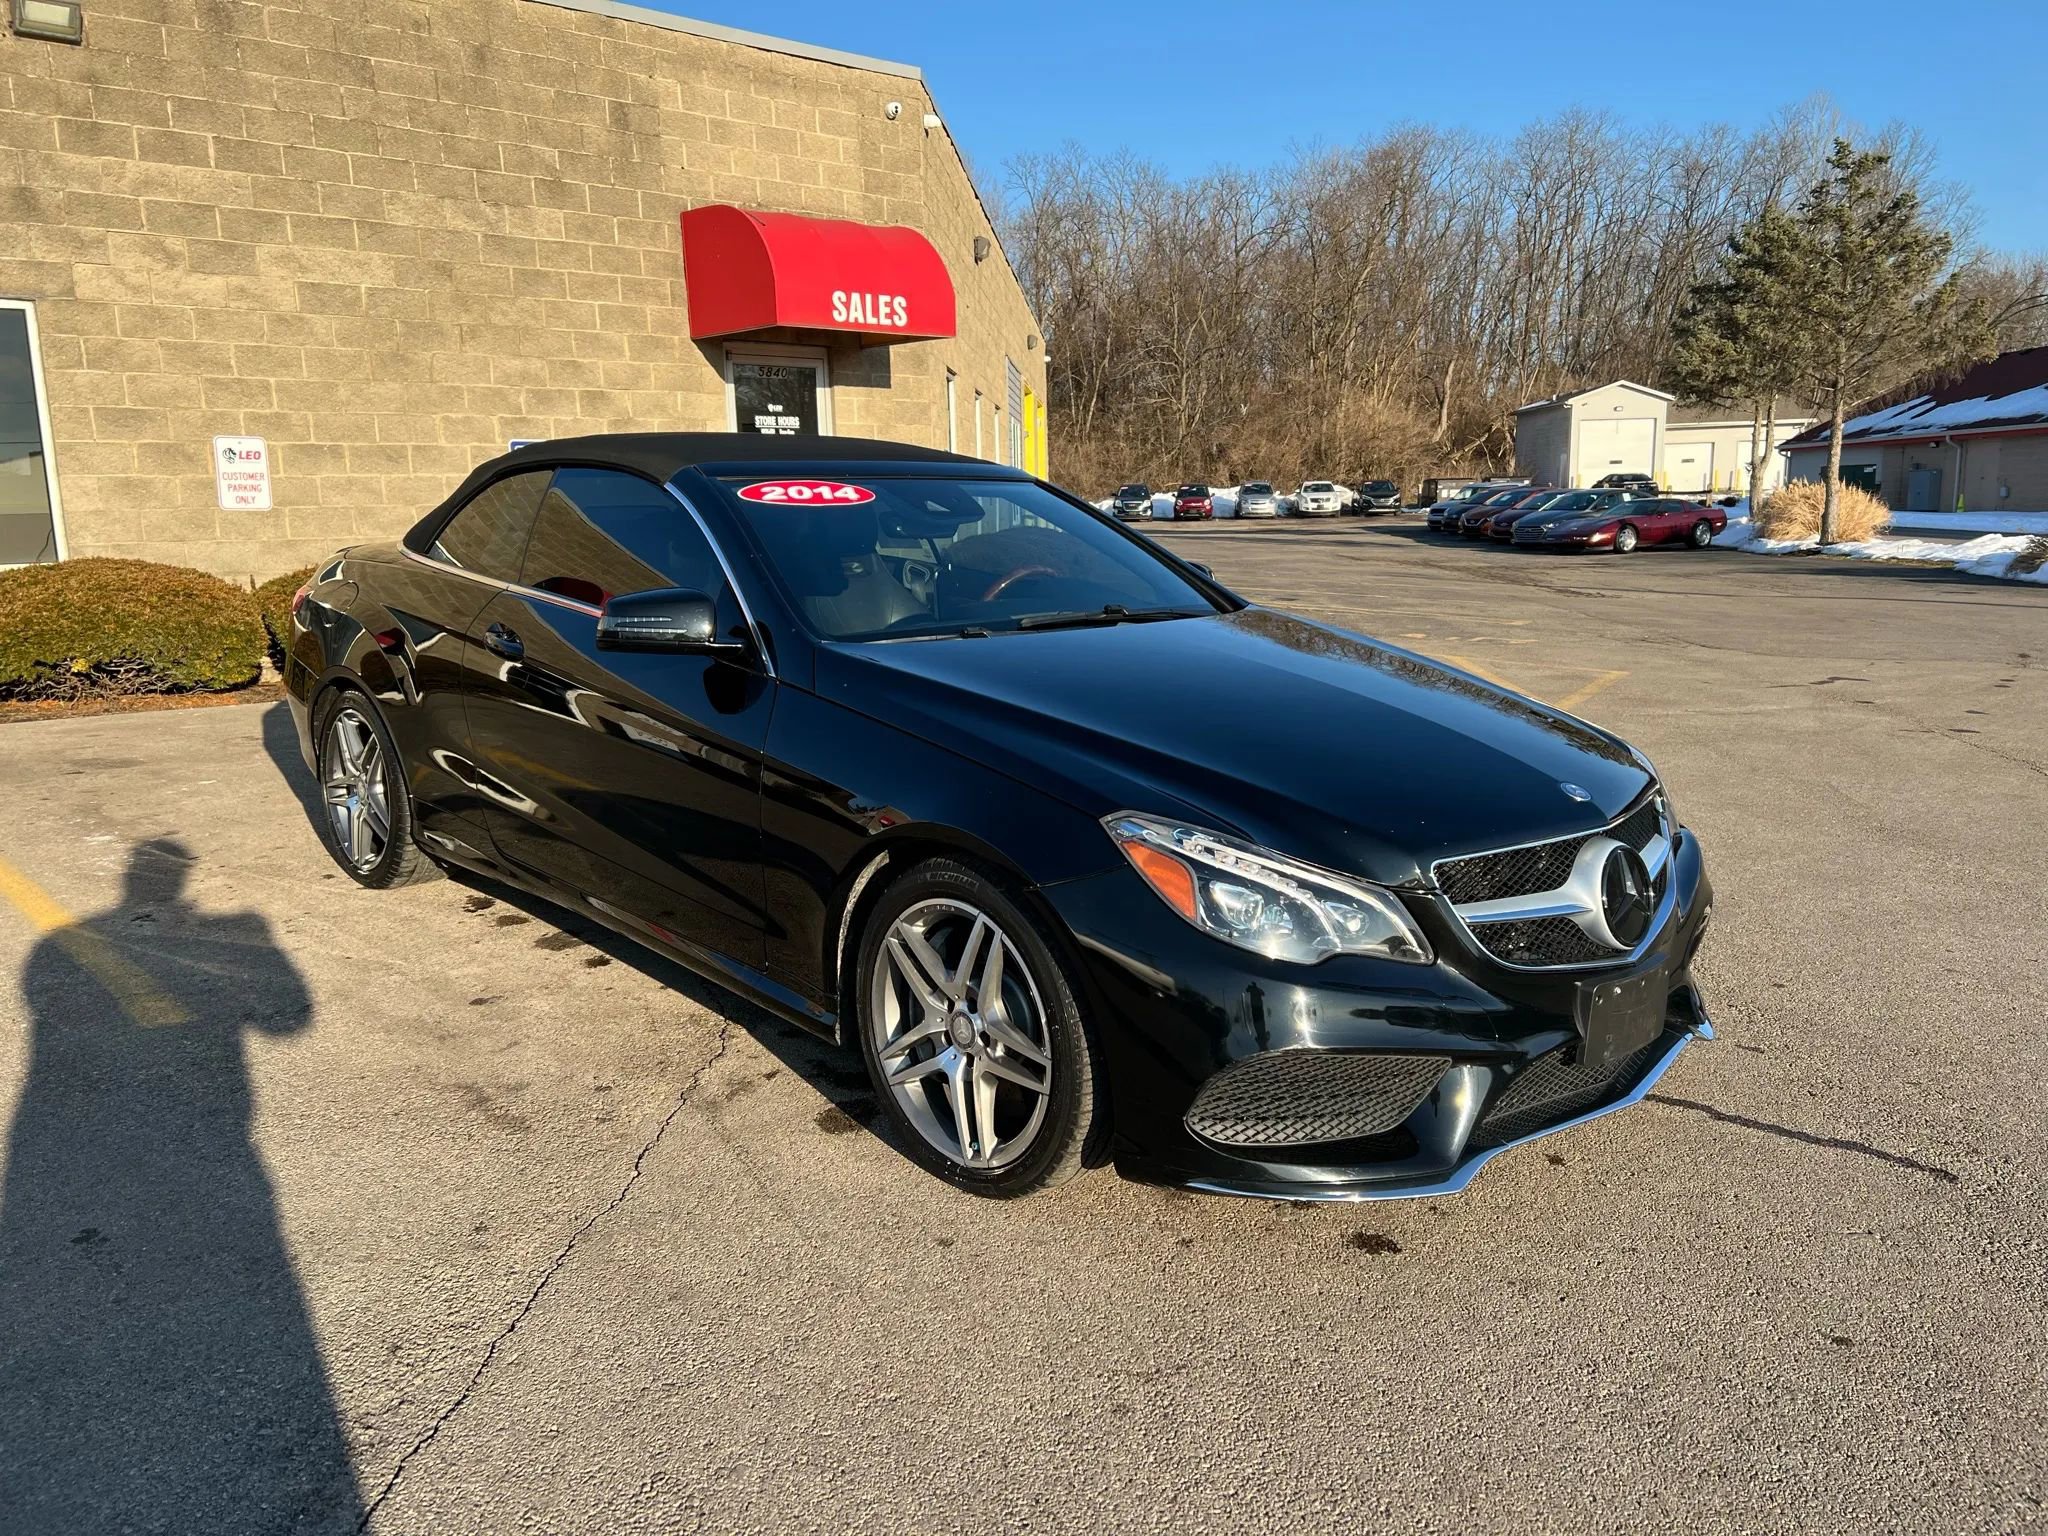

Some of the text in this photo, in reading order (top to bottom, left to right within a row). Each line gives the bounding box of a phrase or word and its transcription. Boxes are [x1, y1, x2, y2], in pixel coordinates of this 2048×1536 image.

[832, 290, 908, 327] SALES
[758, 367, 788, 378] 5840
[755, 415, 800, 426] STORE HOURS
[239, 451, 261, 460] LEO
[222, 472, 265, 481] CUSTOMER
[227, 484, 262, 493] PARKING
[760, 485, 860, 501] 2014
[235, 496, 256, 504] ONLY
